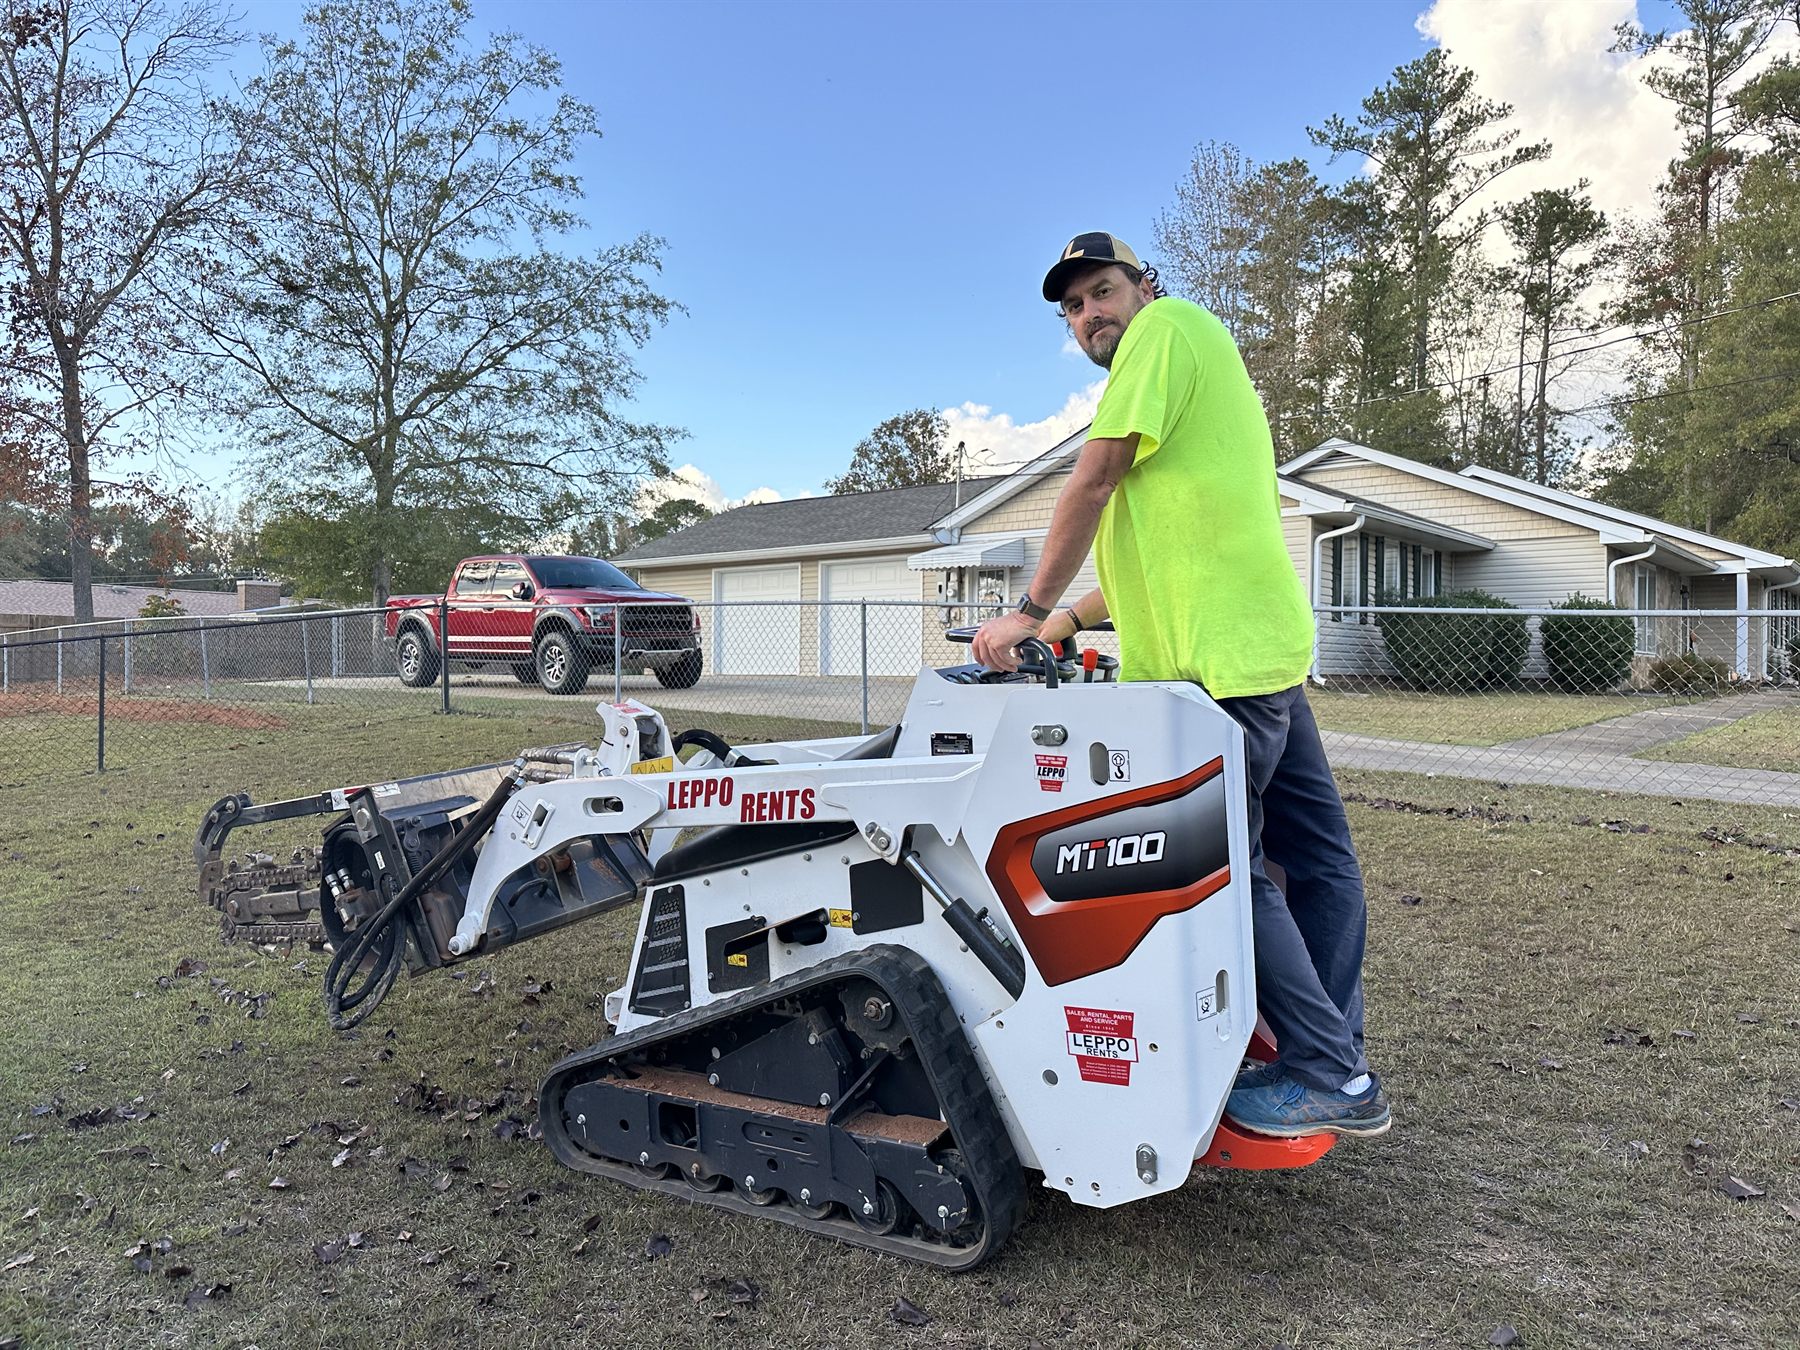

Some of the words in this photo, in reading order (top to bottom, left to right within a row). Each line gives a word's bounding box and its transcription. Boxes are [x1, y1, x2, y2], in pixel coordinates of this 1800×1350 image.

[1037, 766, 1065, 778] LEPPO
[667, 776, 734, 810] LEPPO
[740, 788, 816, 823] RENTS
[1056, 831, 1167, 874] MT100
[1093, 1018, 1119, 1026] SERVICE
[1073, 1033, 1129, 1052] LEPPO
[1086, 1047, 1119, 1059] RENTS
